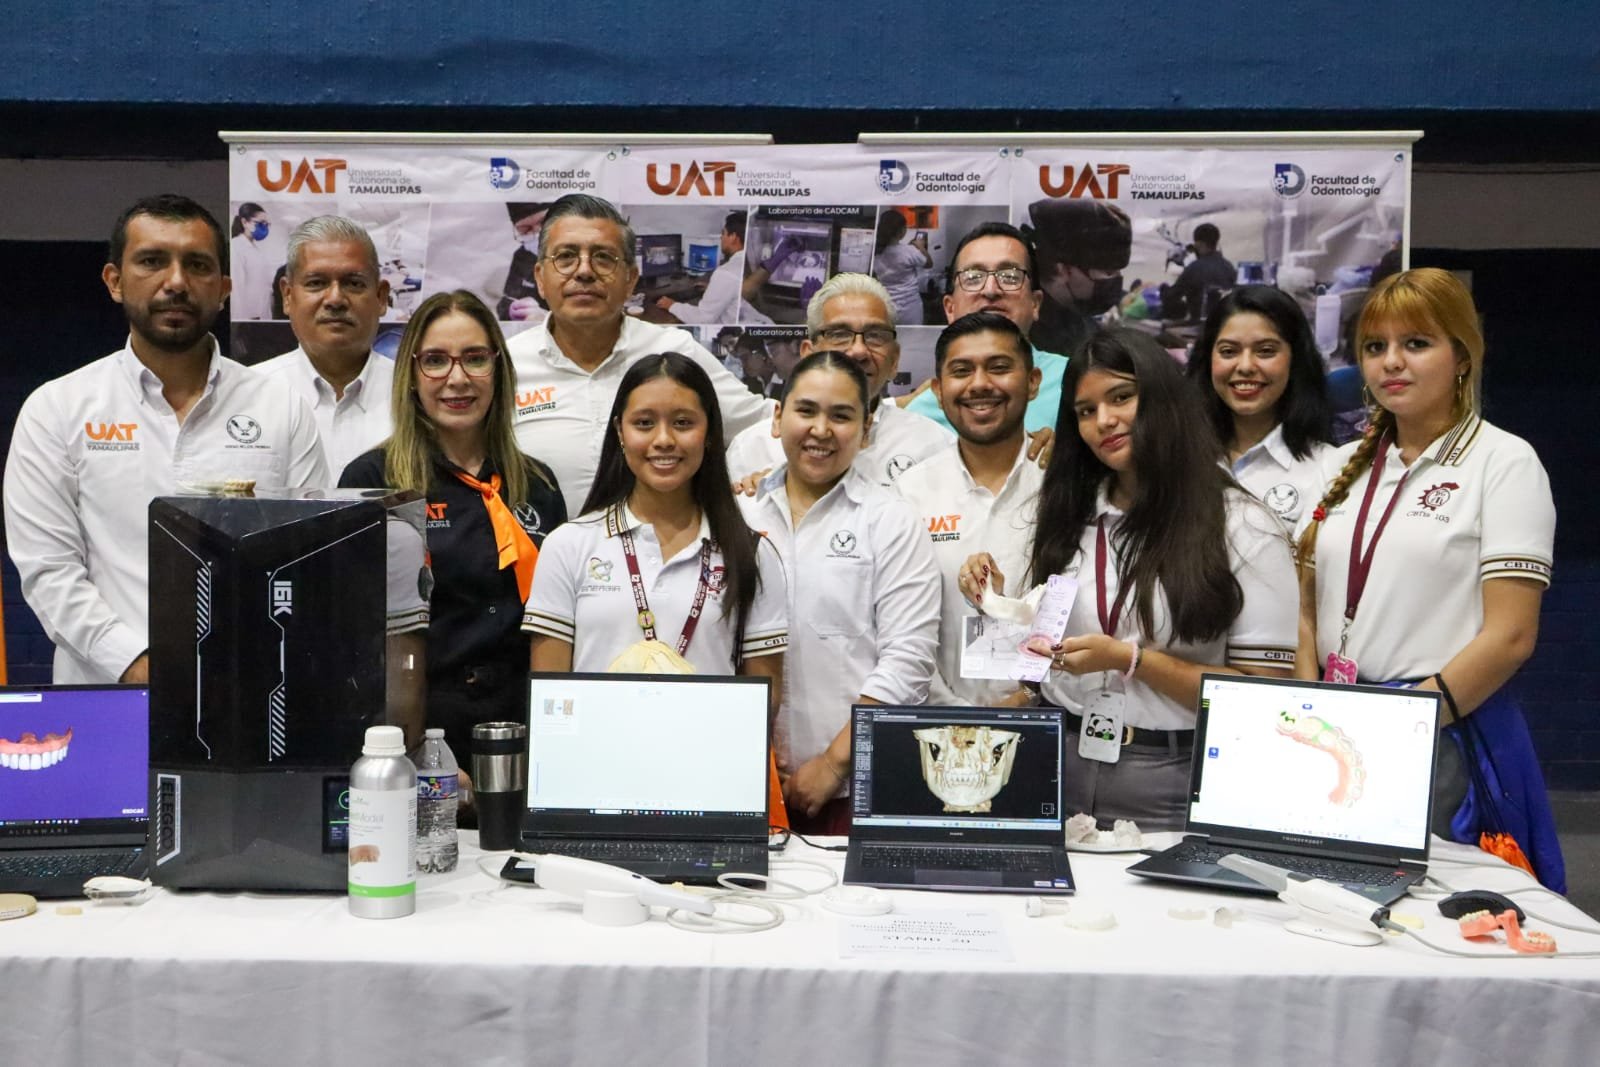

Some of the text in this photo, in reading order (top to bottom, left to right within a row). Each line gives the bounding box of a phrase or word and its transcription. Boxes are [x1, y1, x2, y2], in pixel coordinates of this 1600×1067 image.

[257, 157, 347, 193] UAT
[348, 169, 402, 177] Universidad
[526, 169, 591, 178] Facultad de
[737, 170, 791, 178] Universidad
[916, 172, 981, 181] Facultad de
[400, 176, 411, 184] de
[647, 160, 736, 196] UAT
[789, 178, 800, 186] de
[1039, 162, 1130, 199] UAT
[1131, 174, 1186, 182] Universidad
[1311, 175, 1376, 185] Facultad de
[349, 185, 422, 194] TAMAULIPAS
[1183, 182, 1195, 190] de
[737, 188, 811, 197] TAMAULIPAS
[1131, 191, 1205, 200] TAMAULIPAS
[768, 207, 860, 215] Laboratorio de CADCAM
[515, 386, 556, 407] UAT
[85, 422, 138, 441] UAT
[425, 503, 448, 519] AT
